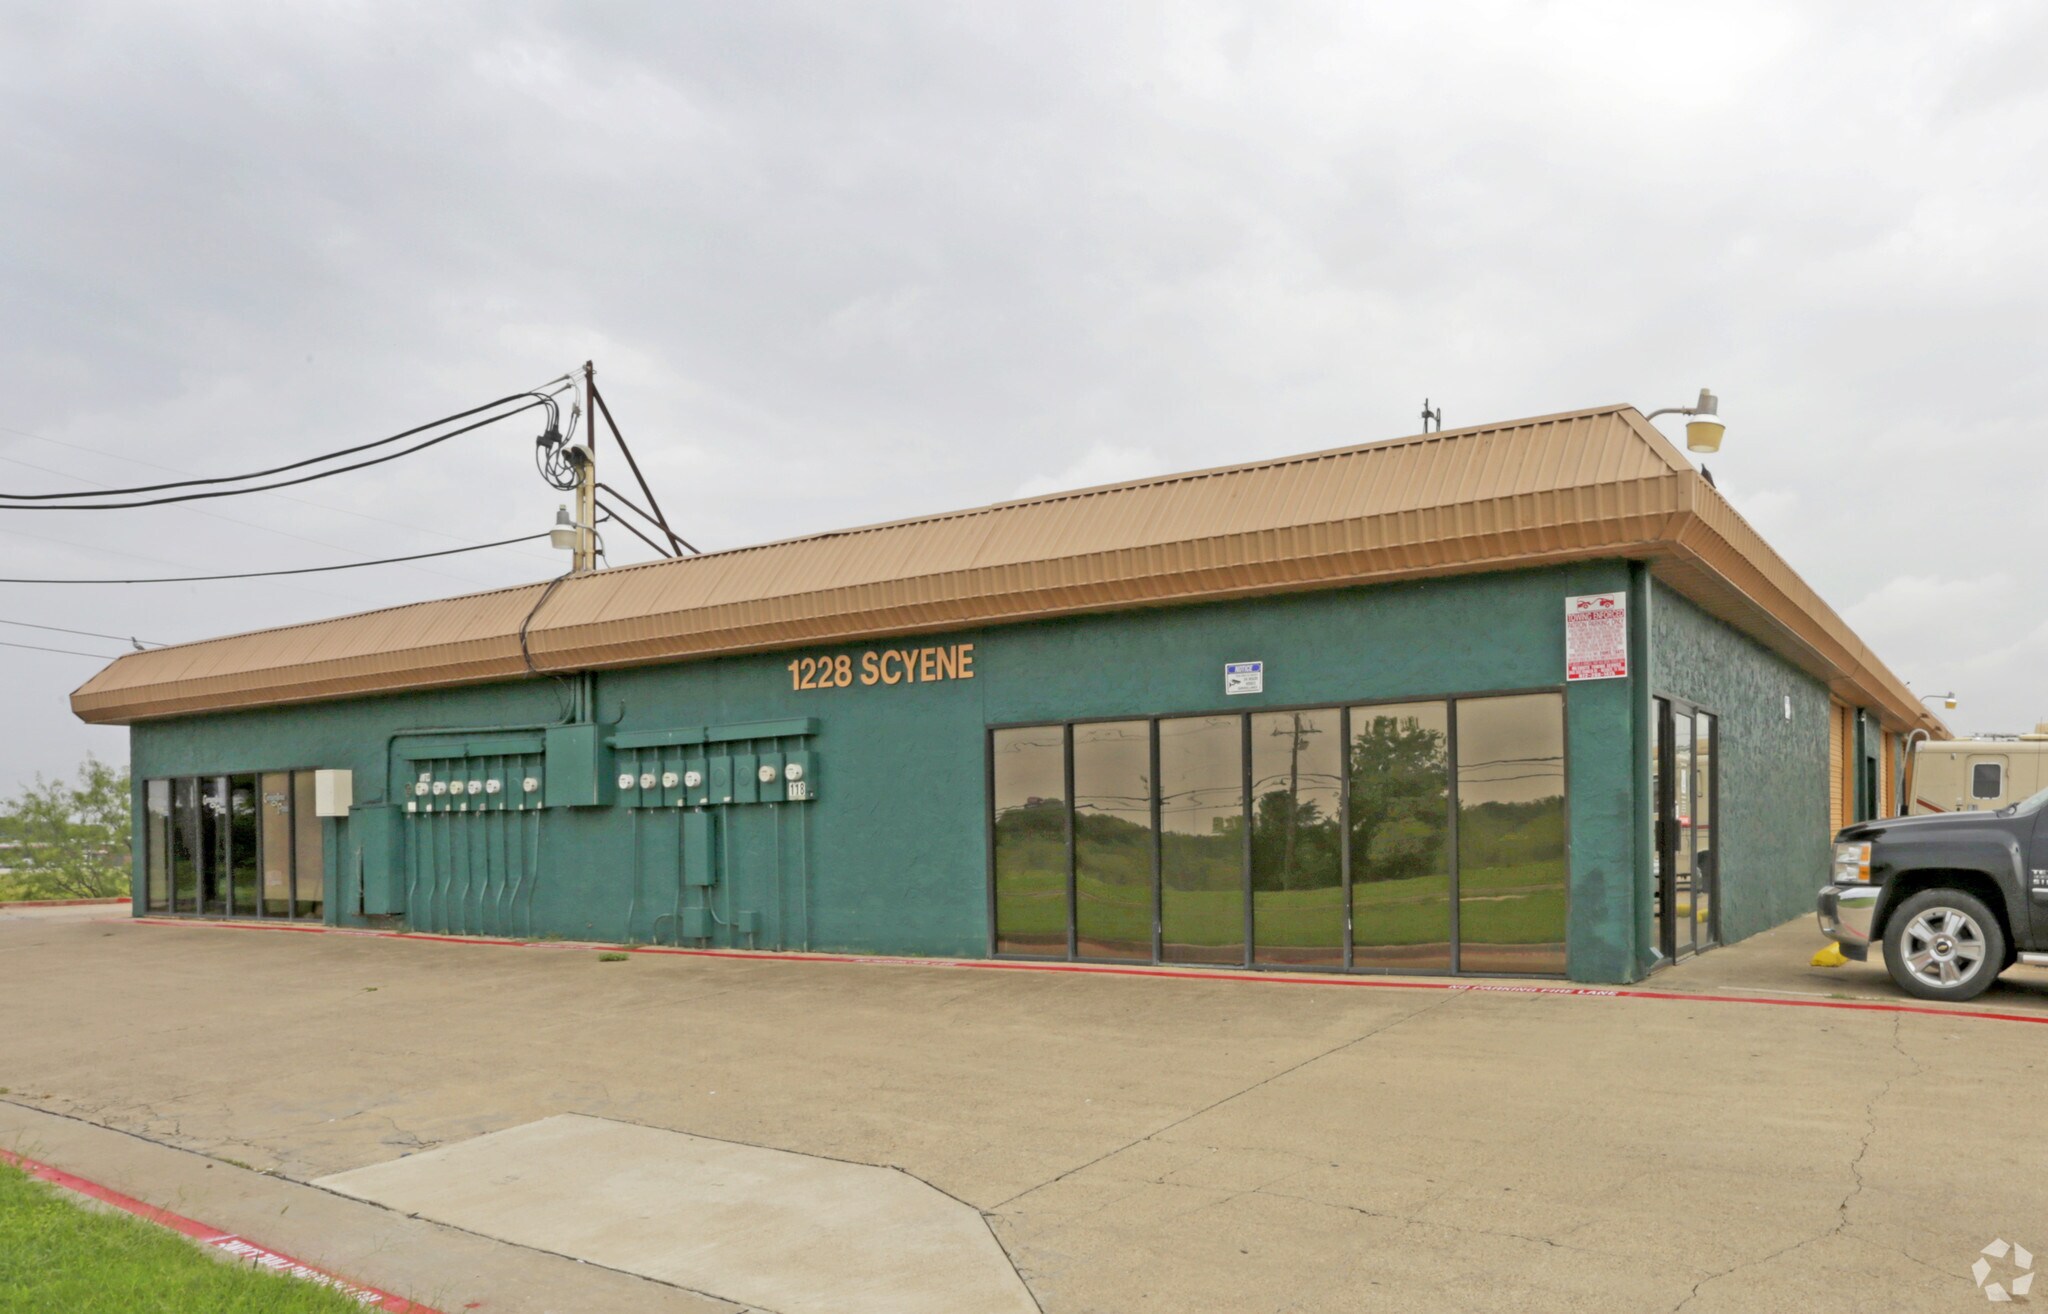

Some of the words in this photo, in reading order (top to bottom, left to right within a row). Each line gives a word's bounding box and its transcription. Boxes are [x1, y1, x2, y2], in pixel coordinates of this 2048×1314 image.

[1593, 609, 1625, 619] ENFORCED
[788, 654, 853, 691] 1228
[860, 644, 974, 686] SCYENE
[790, 783, 805, 795] 118
[1577, 989, 1617, 997] LANE
